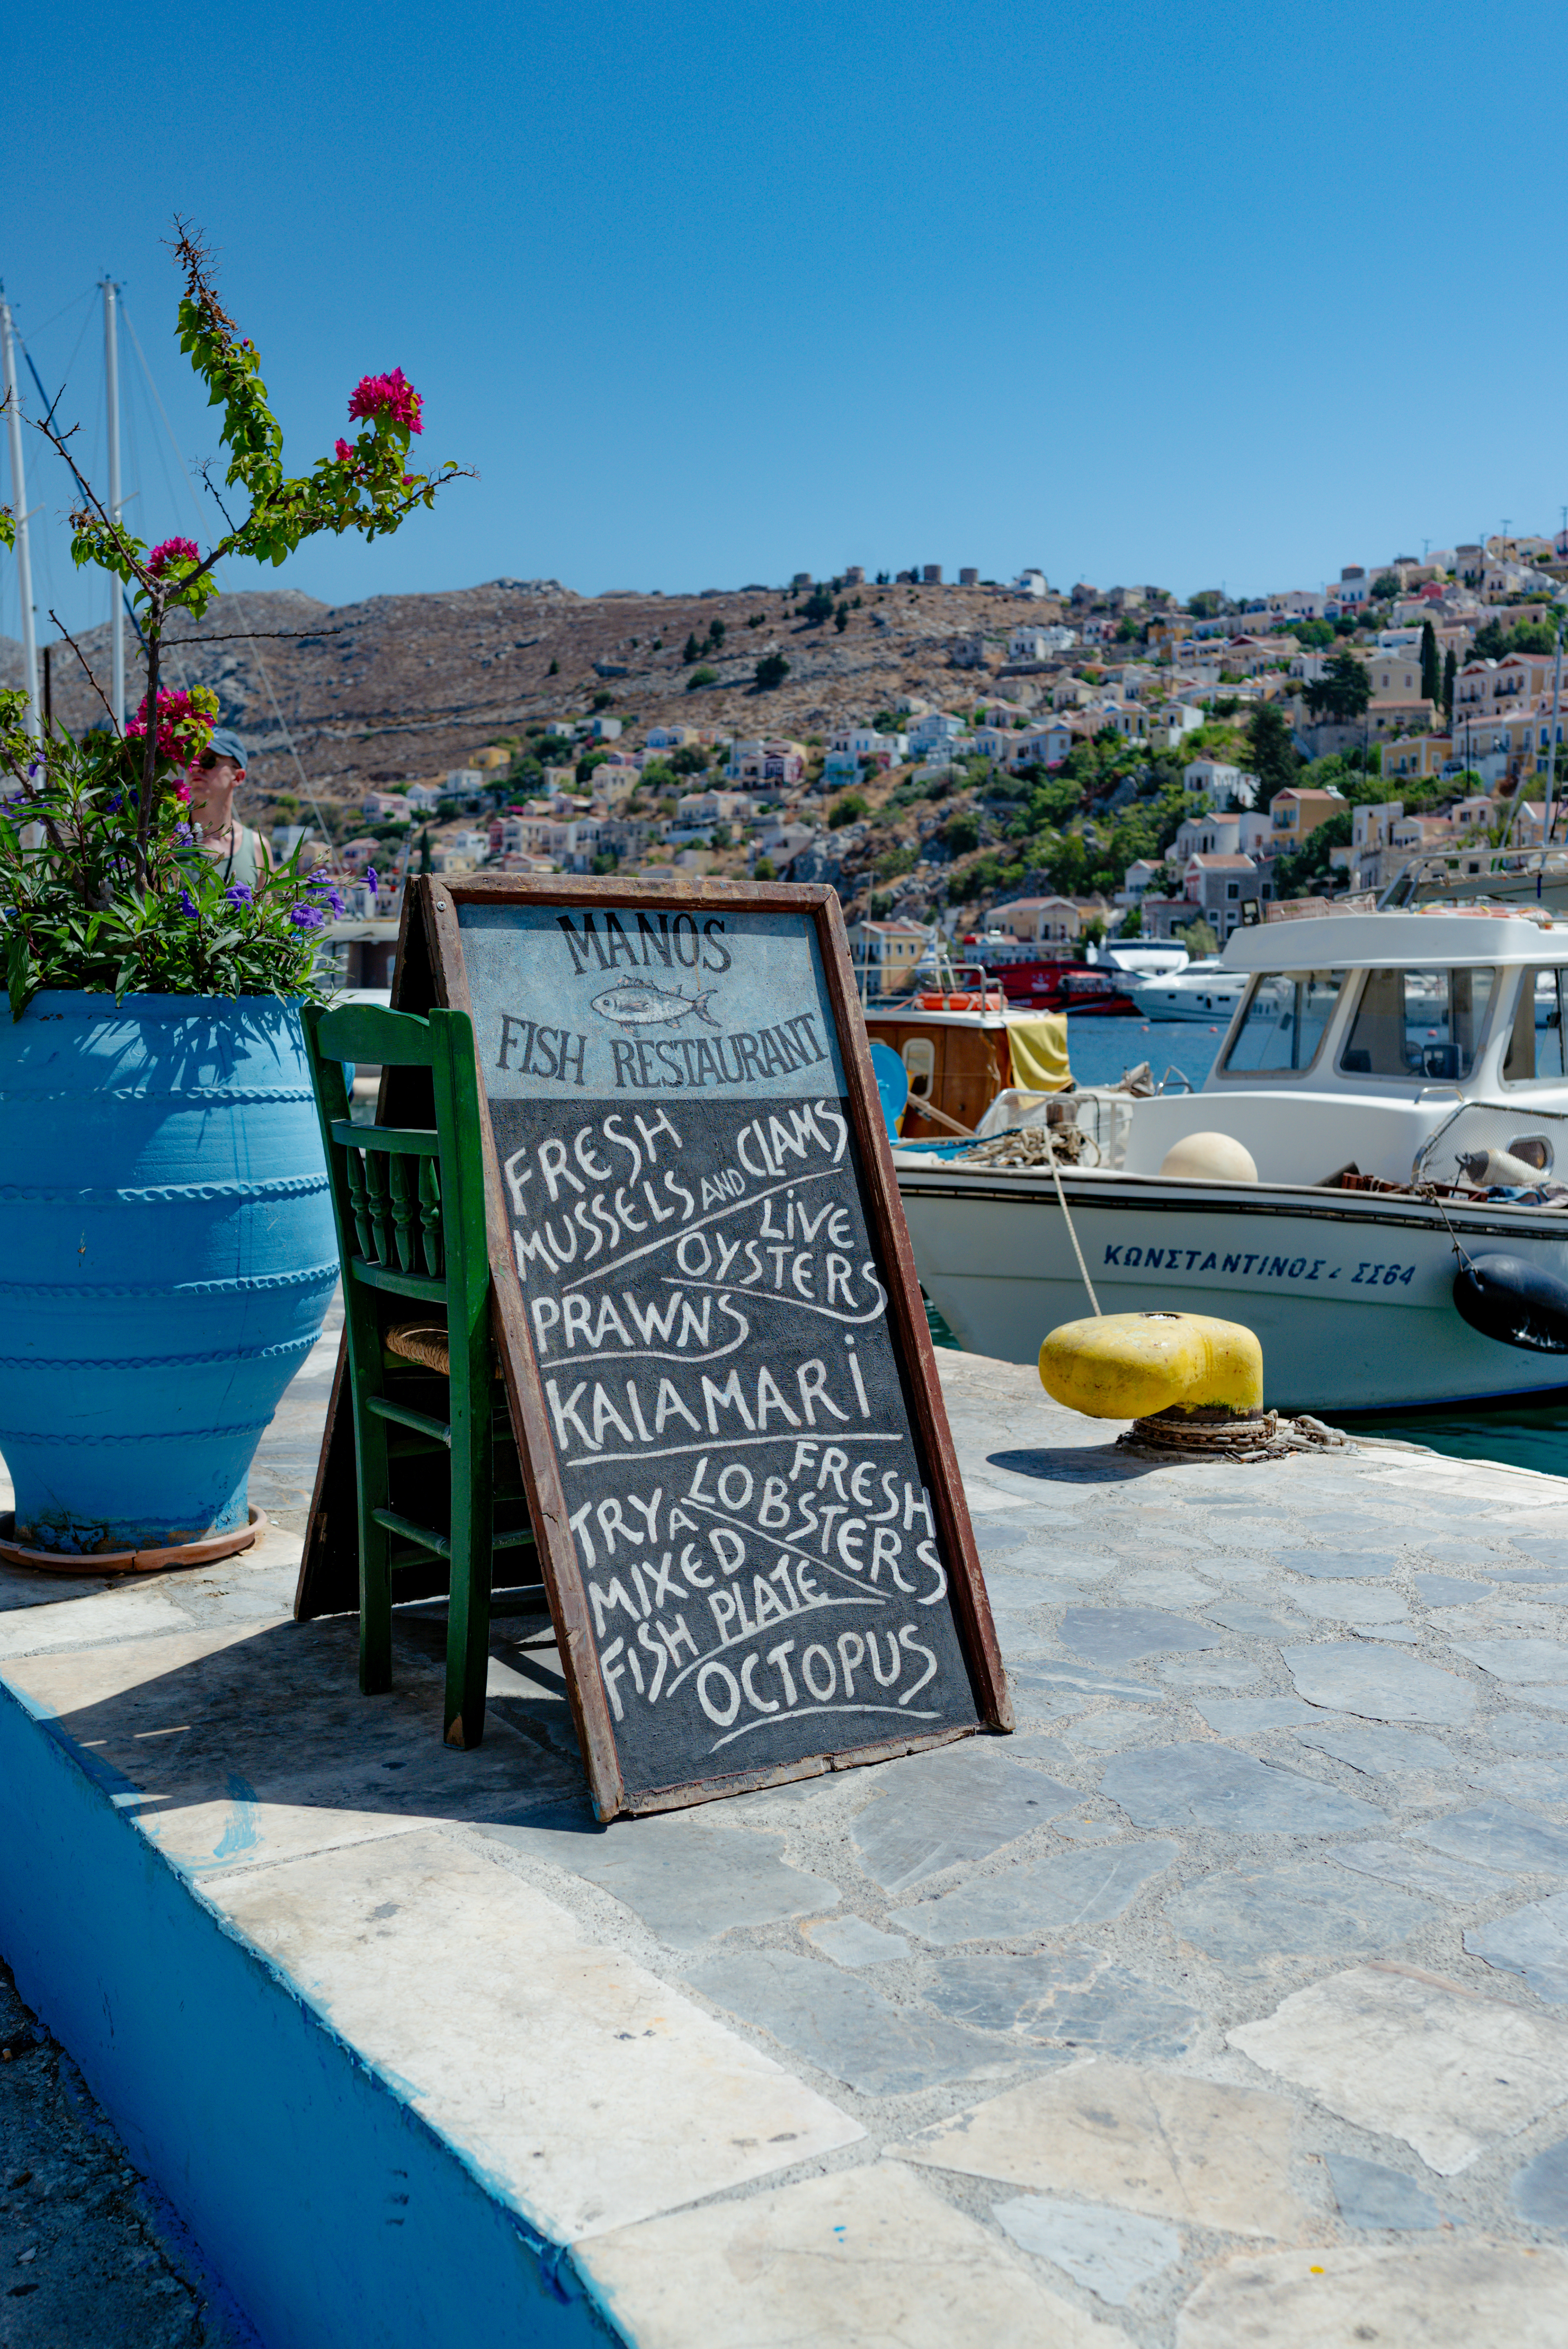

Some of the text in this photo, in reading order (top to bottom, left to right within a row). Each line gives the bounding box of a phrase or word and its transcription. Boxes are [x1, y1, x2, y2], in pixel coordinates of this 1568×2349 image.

[556, 912, 732, 975] MANOS
[495, 1012, 829, 1088] FISH RESTAURANT
[504, 1108, 682, 1216] FRESH
[513, 1100, 848, 1281] MUSSELS AND CLAMS
[676, 1231, 888, 1323] OYSTERS
[1103, 1244, 1327, 1280] ΚΩΝΣΤΑΝΤΙΝΟΣ
[531, 1291, 750, 1360] PRAWNS
[569, 1487, 699, 1568] TRY A
[688, 1456, 948, 1605] LOBSTERS
[788, 1441, 936, 1539] FRESH
[588, 1527, 746, 1638] MIXED
[600, 1554, 828, 1722] FISH PLATE
[696, 1623, 938, 1727] OCTOPUS
